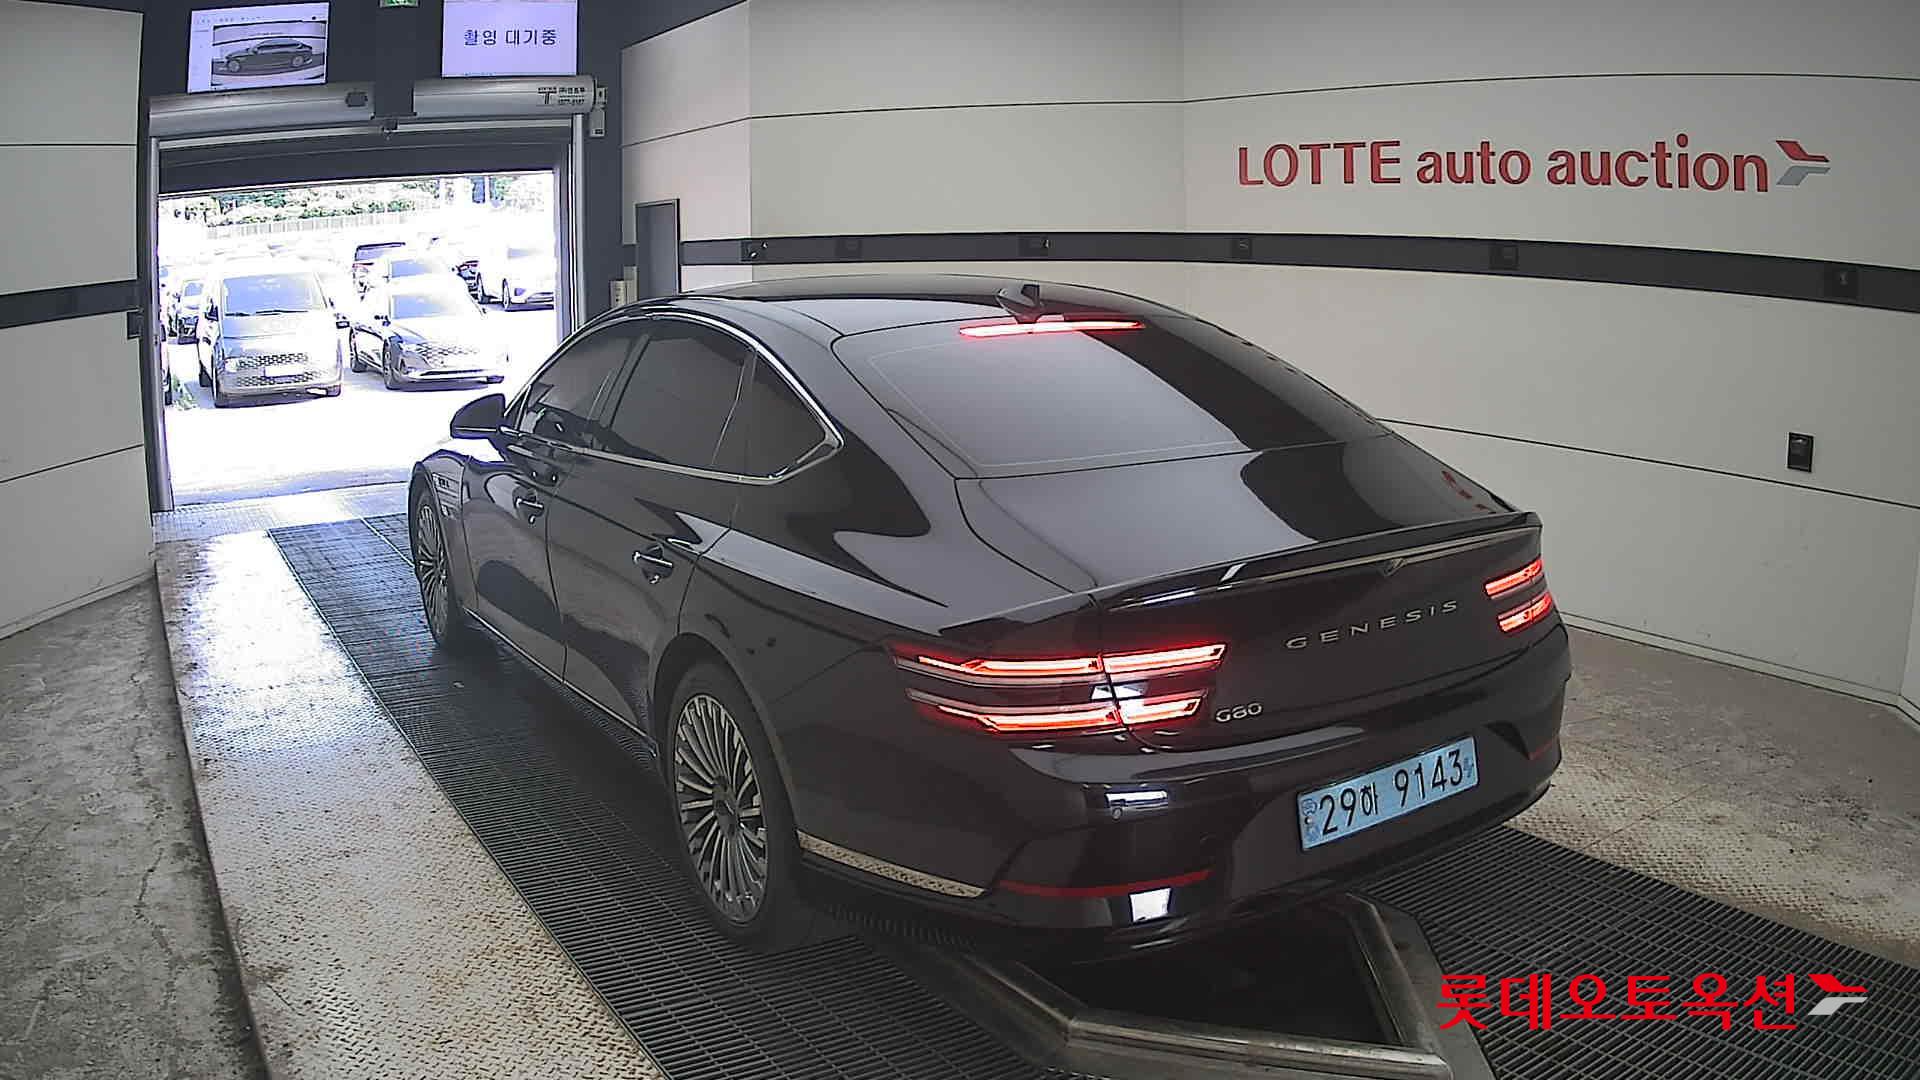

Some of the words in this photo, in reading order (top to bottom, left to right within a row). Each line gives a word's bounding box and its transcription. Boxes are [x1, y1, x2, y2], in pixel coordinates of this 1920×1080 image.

[505, 29, 558, 46] 대기중
[1238, 140, 1401, 187] LOTTE
[1416, 141, 1532, 185] auto
[1547, 133, 1769, 193] auction
[1286, 600, 1458, 649] GENESIS
[1215, 702, 1263, 723] G80
[1319, 782, 1379, 836] 29하
[1393, 748, 1464, 808] 9143
